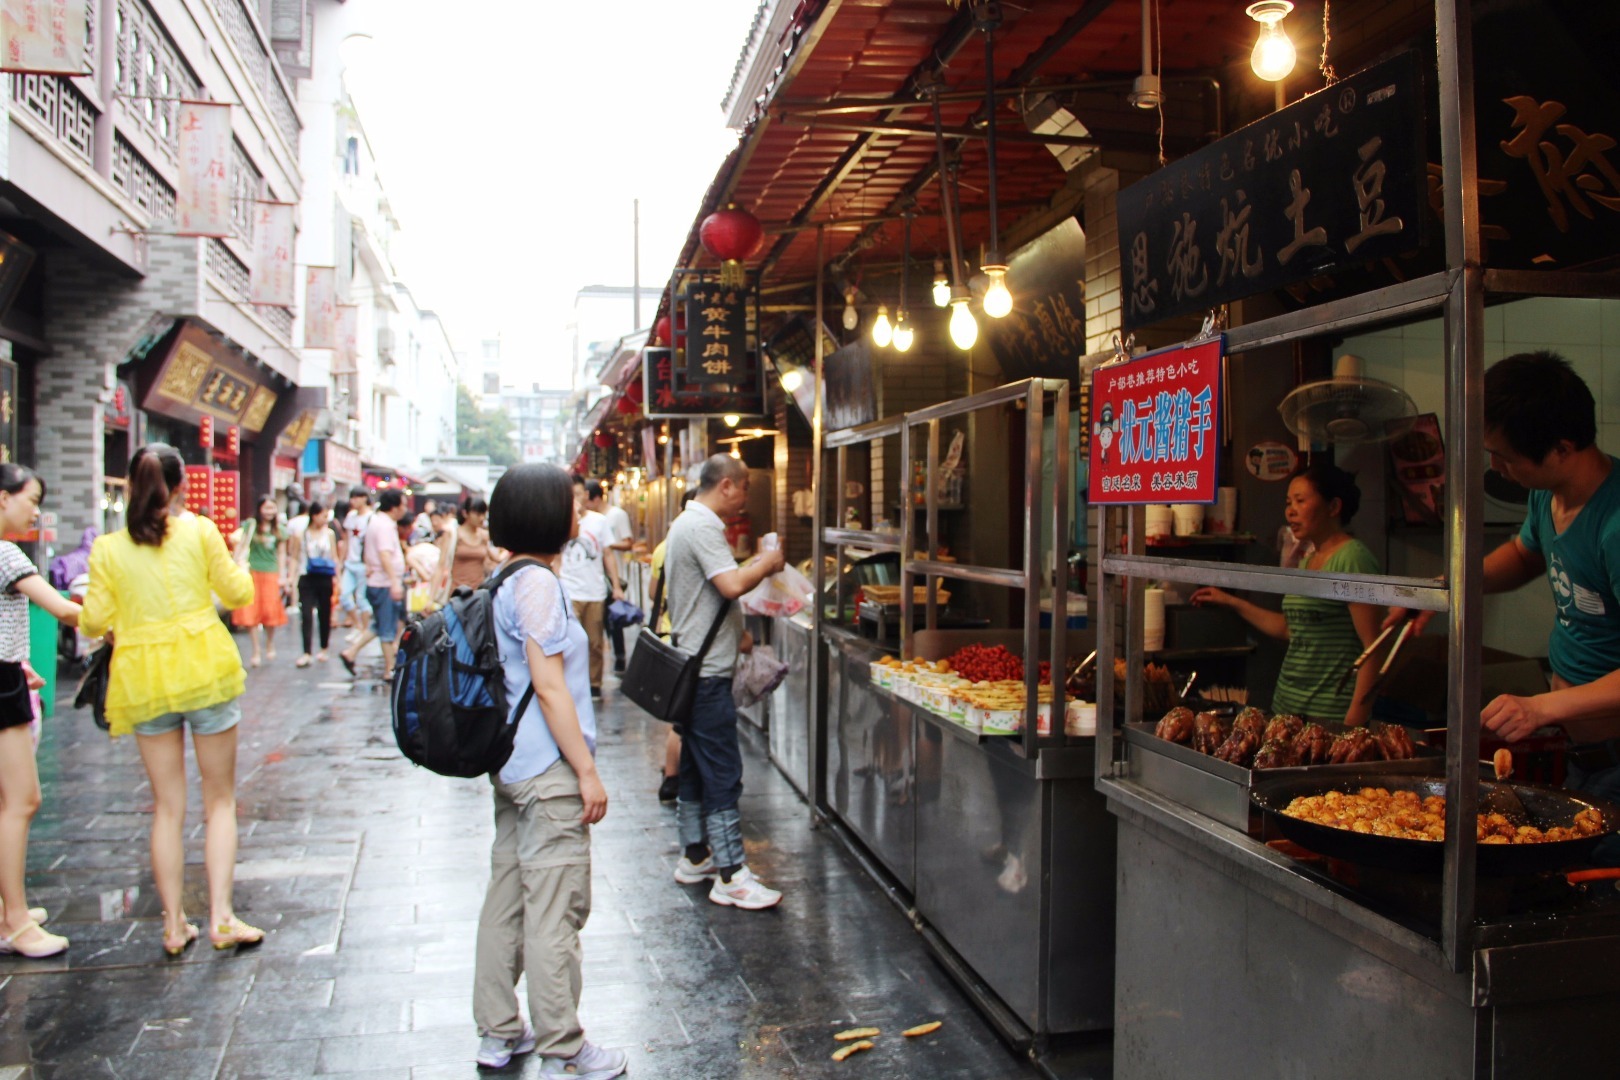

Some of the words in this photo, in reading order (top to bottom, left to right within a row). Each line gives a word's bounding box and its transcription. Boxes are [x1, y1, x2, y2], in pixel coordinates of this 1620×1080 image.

[1129, 136, 1404, 314] 恩施炕土豆
[1108, 359, 1200, 393] 户部巷推荐特色小吃
[1118, 384, 1212, 465] 状元酱猪手
